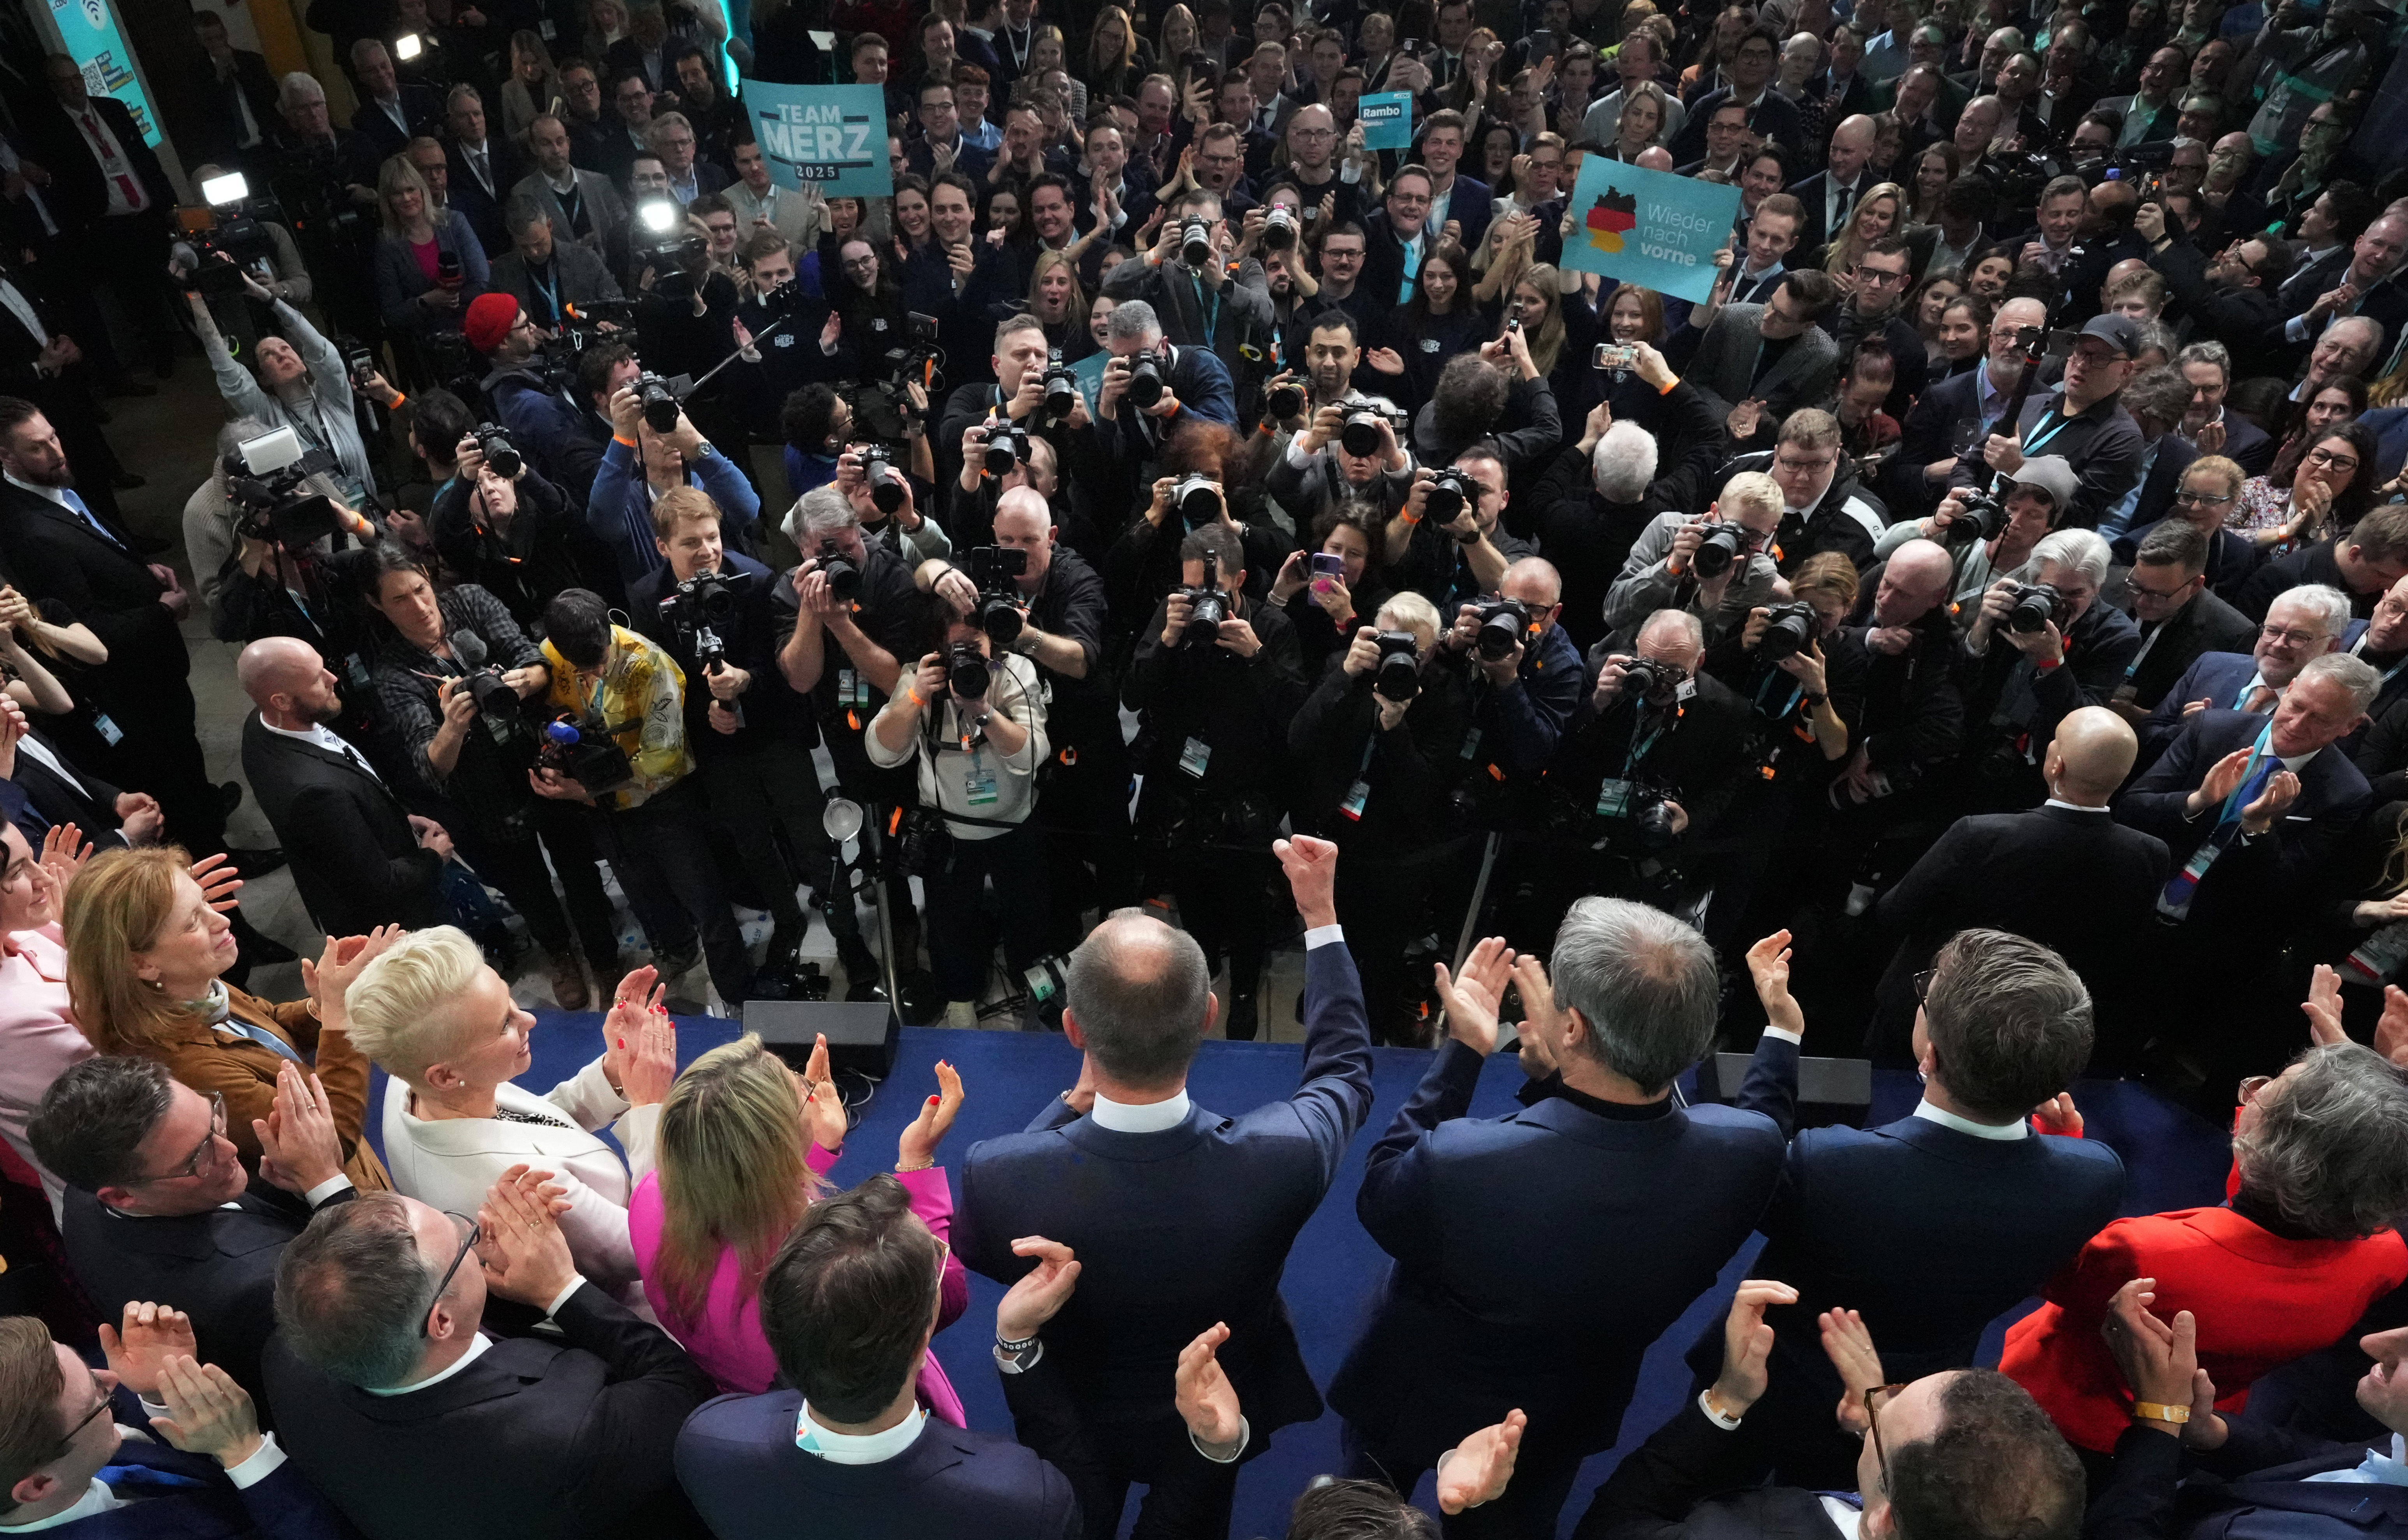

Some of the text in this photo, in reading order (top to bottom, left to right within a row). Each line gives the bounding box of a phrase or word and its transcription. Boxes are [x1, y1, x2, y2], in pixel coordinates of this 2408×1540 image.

[778, 104, 840, 123] TEAM
[1363, 106, 1400, 118] Rambo
[760, 121, 873, 160] MERZ
[797, 166, 836, 178] 2025
[1648, 203, 1714, 234] Wieder
[1643, 224, 1688, 247] nach
[1641, 242, 1697, 267] vorne
[775, 336, 795, 345] MERZ
[752, 927, 762, 943] AFP
